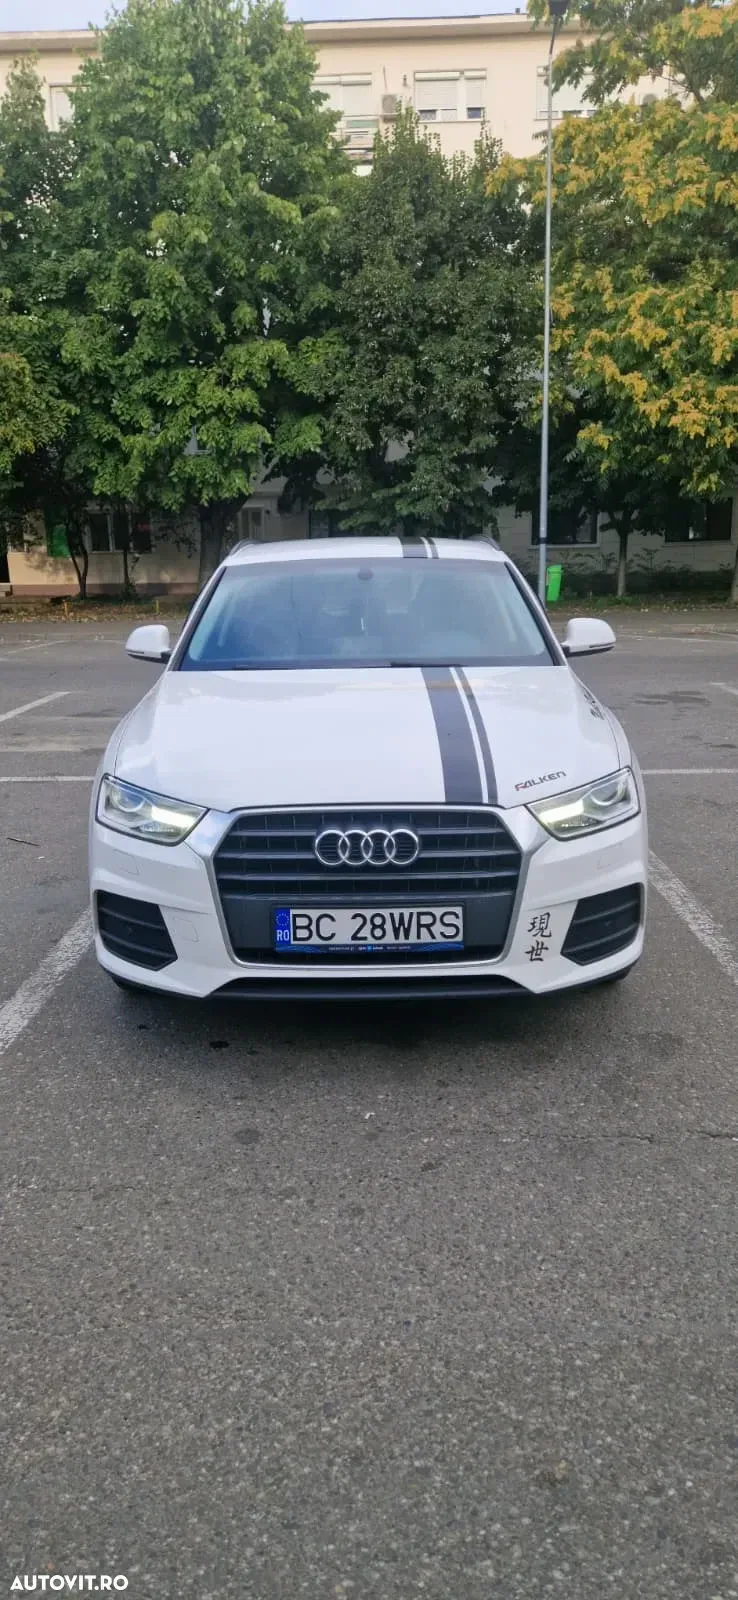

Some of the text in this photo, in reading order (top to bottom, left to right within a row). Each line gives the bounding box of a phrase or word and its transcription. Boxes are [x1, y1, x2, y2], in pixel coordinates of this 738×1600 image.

[514, 770, 567, 791] FALKEN
[276, 929, 290, 942] RO
[292, 911, 461, 942] BC 28WRS
[524, 911, 552, 962] 現世
